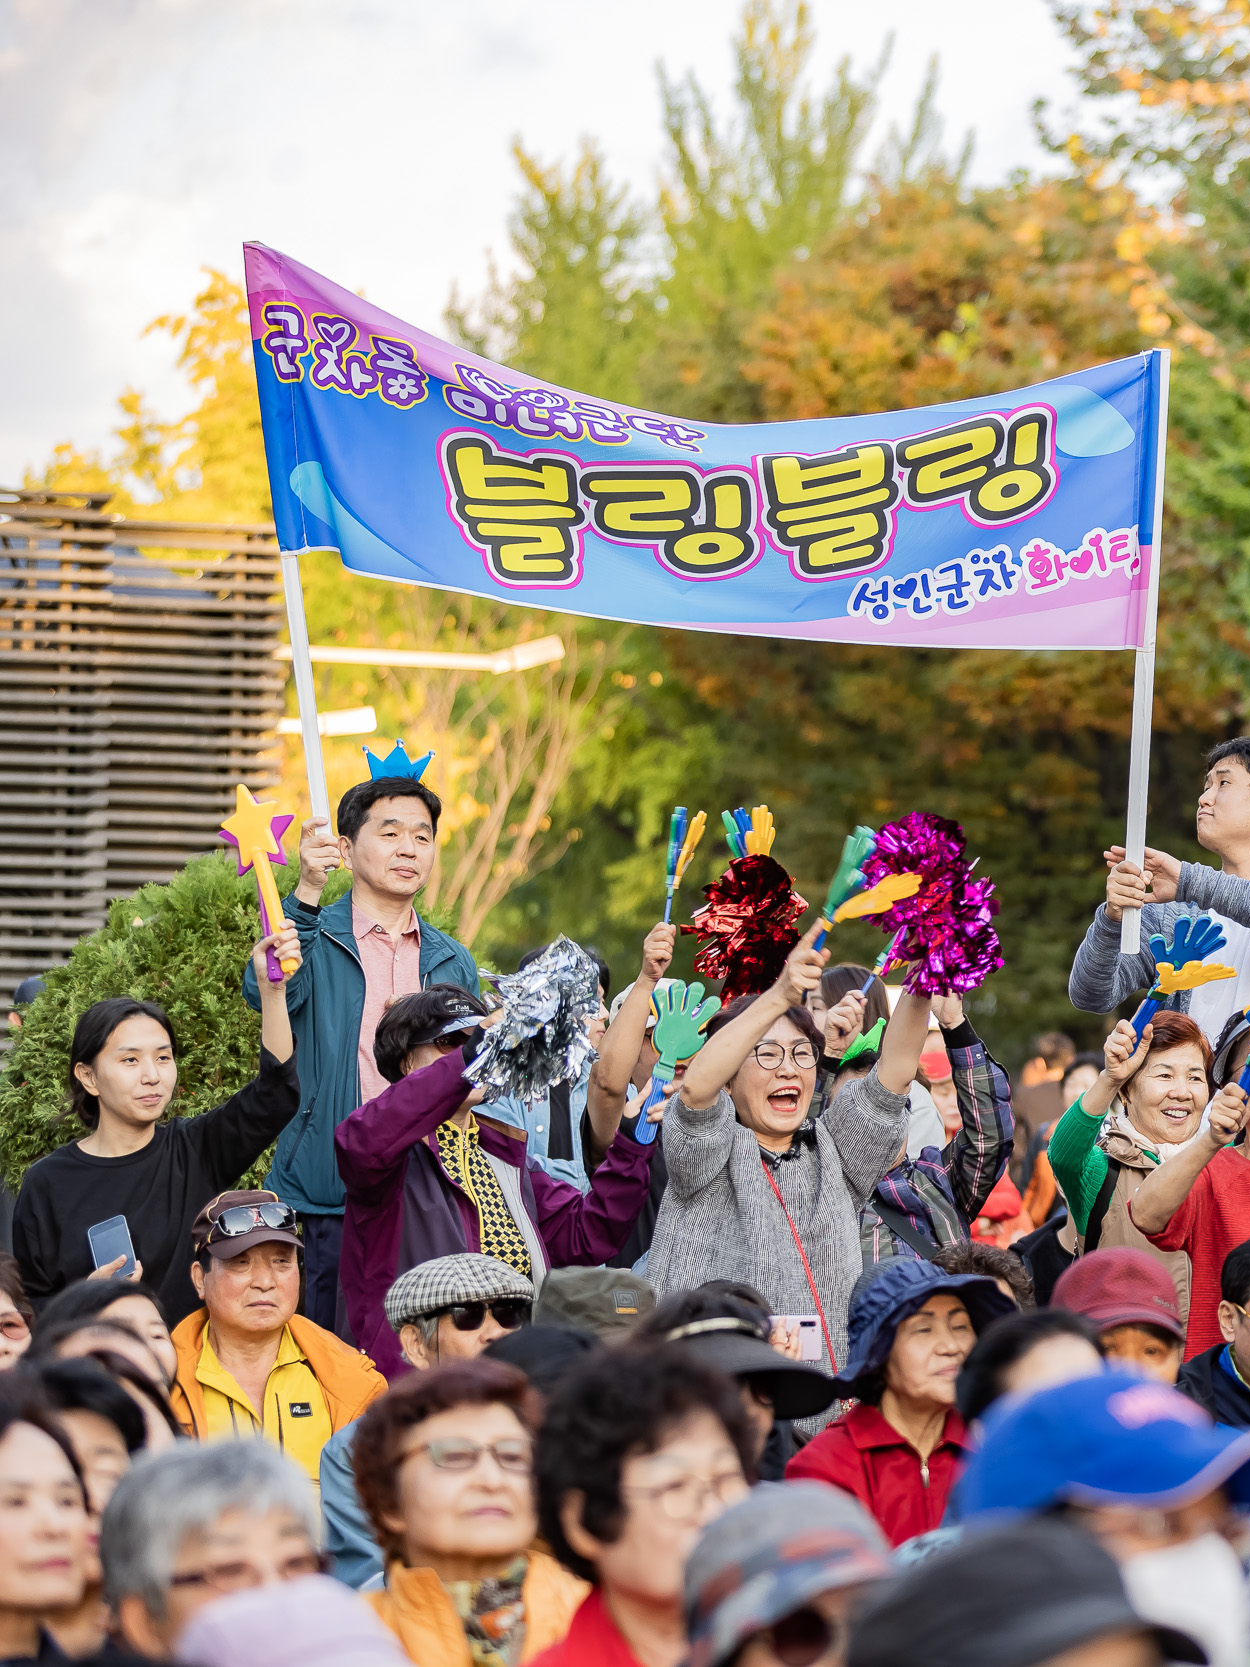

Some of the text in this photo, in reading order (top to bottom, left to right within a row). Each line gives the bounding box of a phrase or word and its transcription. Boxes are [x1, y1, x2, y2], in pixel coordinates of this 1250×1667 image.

[262, 301, 429, 409] 군자동
[442, 410, 1056, 585] 블링블링
[849, 548, 1019, 622] 성인군자
